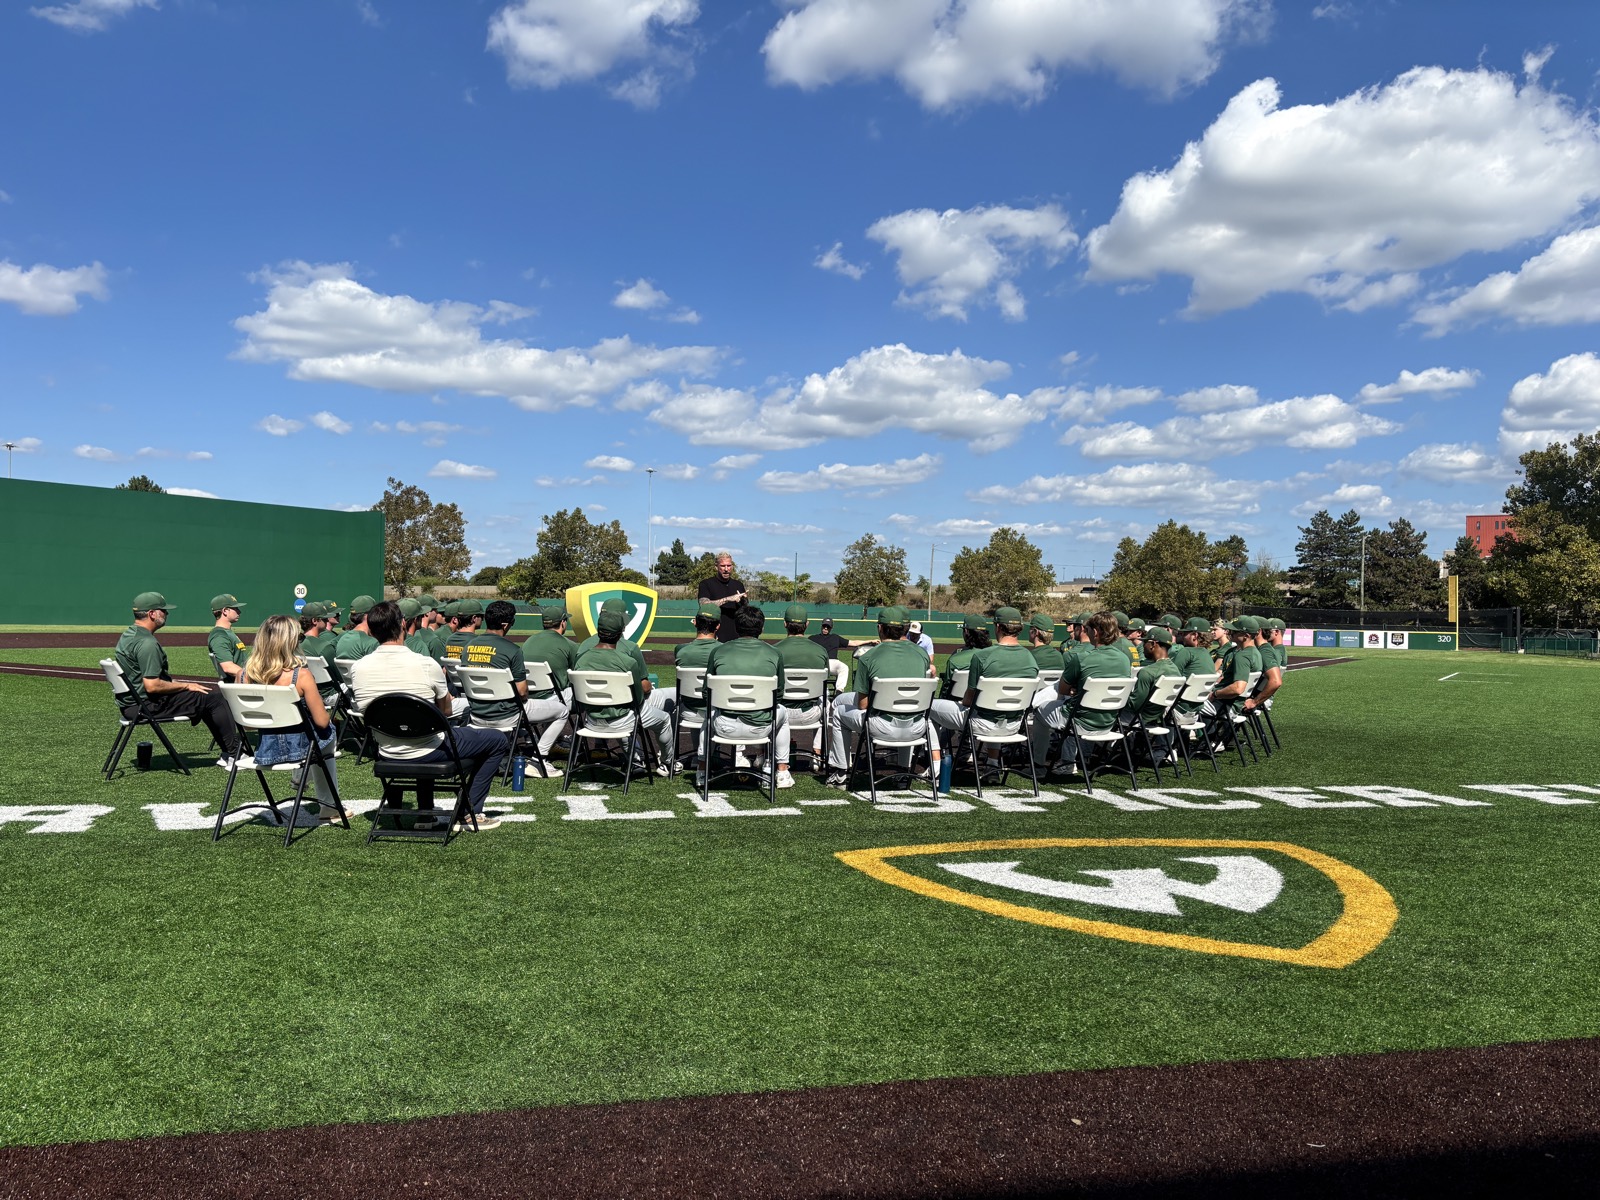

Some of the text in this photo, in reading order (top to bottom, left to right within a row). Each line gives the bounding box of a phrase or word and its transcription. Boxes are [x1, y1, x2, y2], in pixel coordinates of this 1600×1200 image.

[296, 587, 305, 595] 30
[1437, 635, 1452, 643] 320
[467, 645, 497, 656] TRAMMELL
[467, 653, 491, 663] PARRISH
